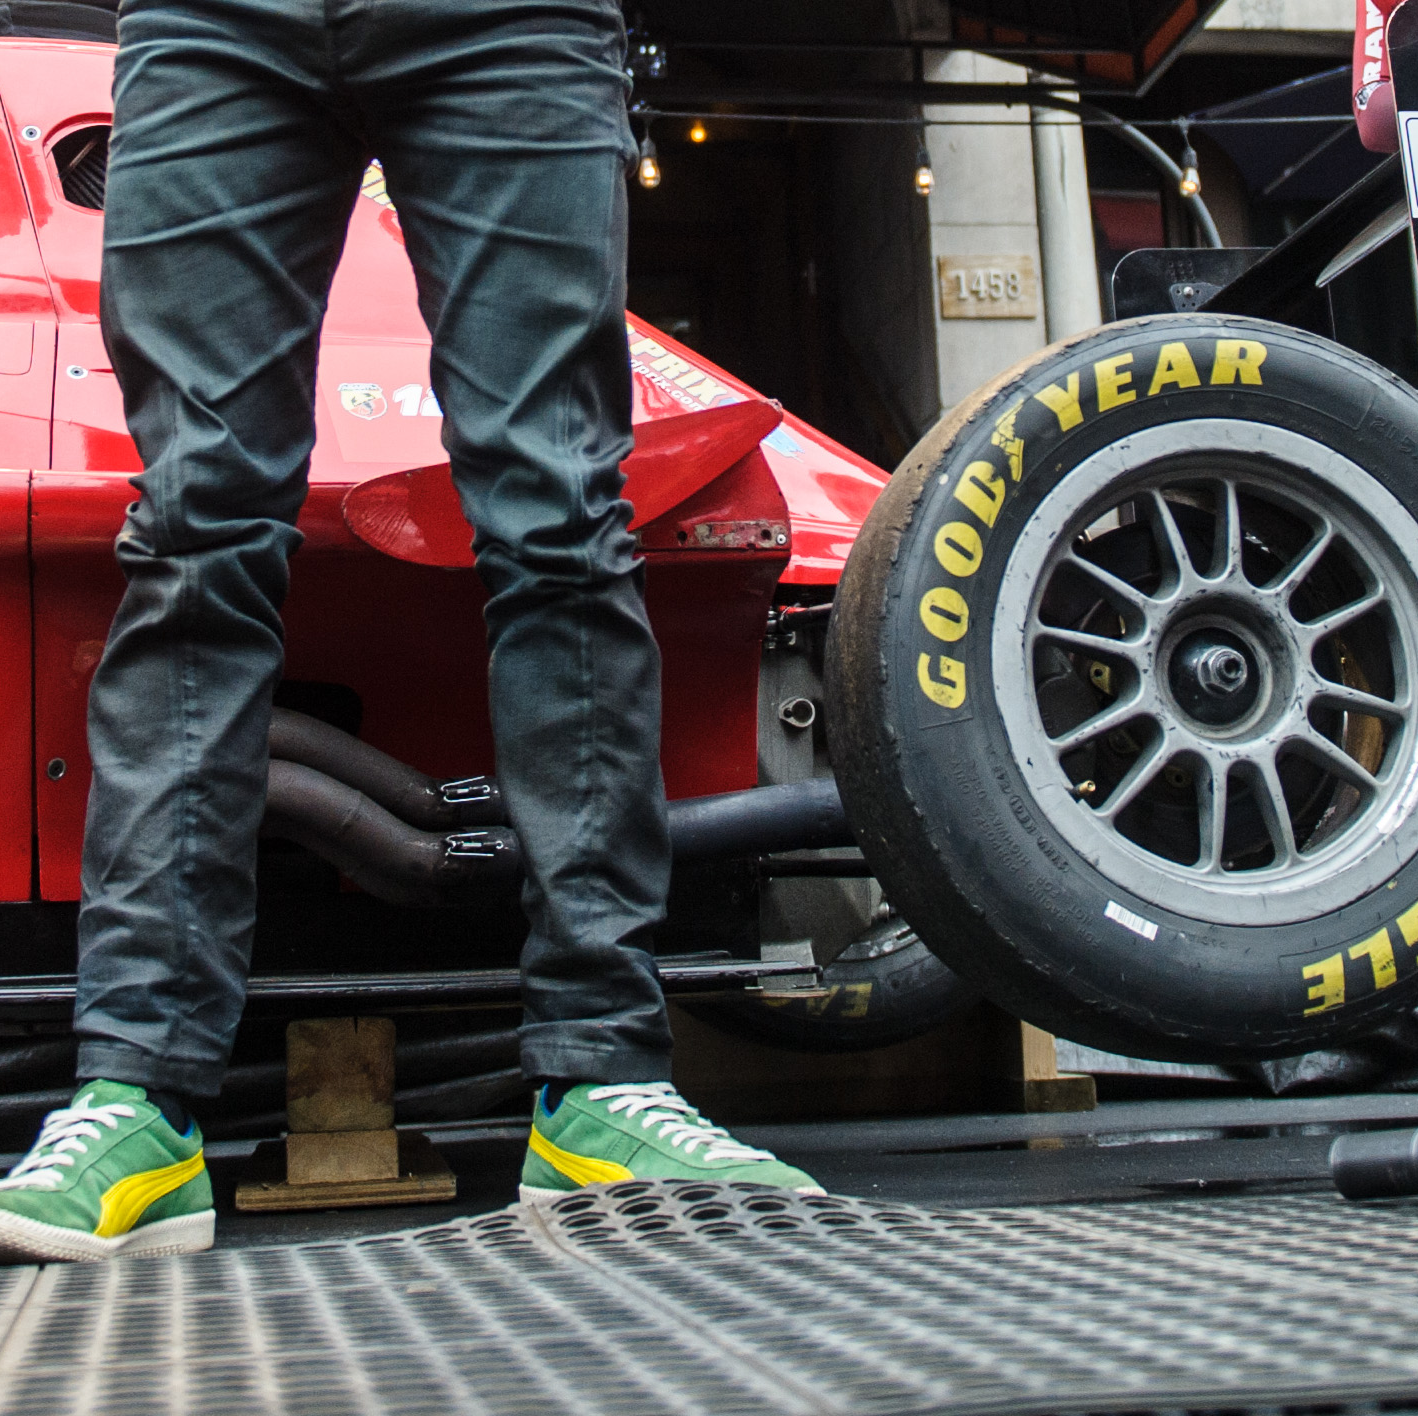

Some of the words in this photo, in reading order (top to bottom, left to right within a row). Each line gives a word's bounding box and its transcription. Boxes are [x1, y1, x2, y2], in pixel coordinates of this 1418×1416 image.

[948, 269, 1021, 300] 1458
[630, 337, 728, 406] PRIX
[917, 339, 1267, 709] GOODYEAR
